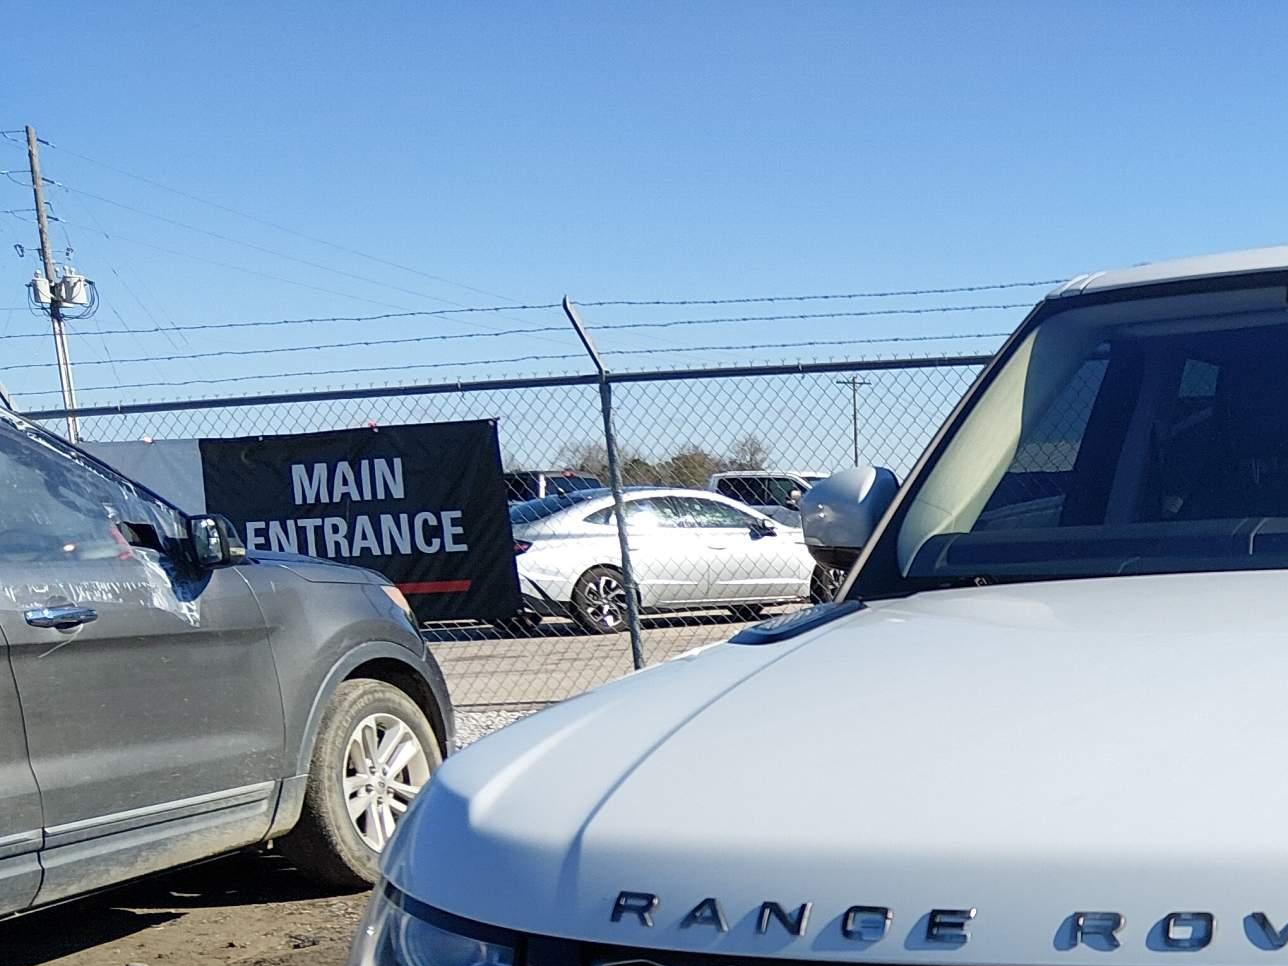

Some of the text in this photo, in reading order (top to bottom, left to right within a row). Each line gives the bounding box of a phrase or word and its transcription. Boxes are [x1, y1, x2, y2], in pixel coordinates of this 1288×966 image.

[291, 457, 405, 505] MAIN
[245, 510, 469, 558] ENTRANCE
[610, 890, 977, 944] RANGE
